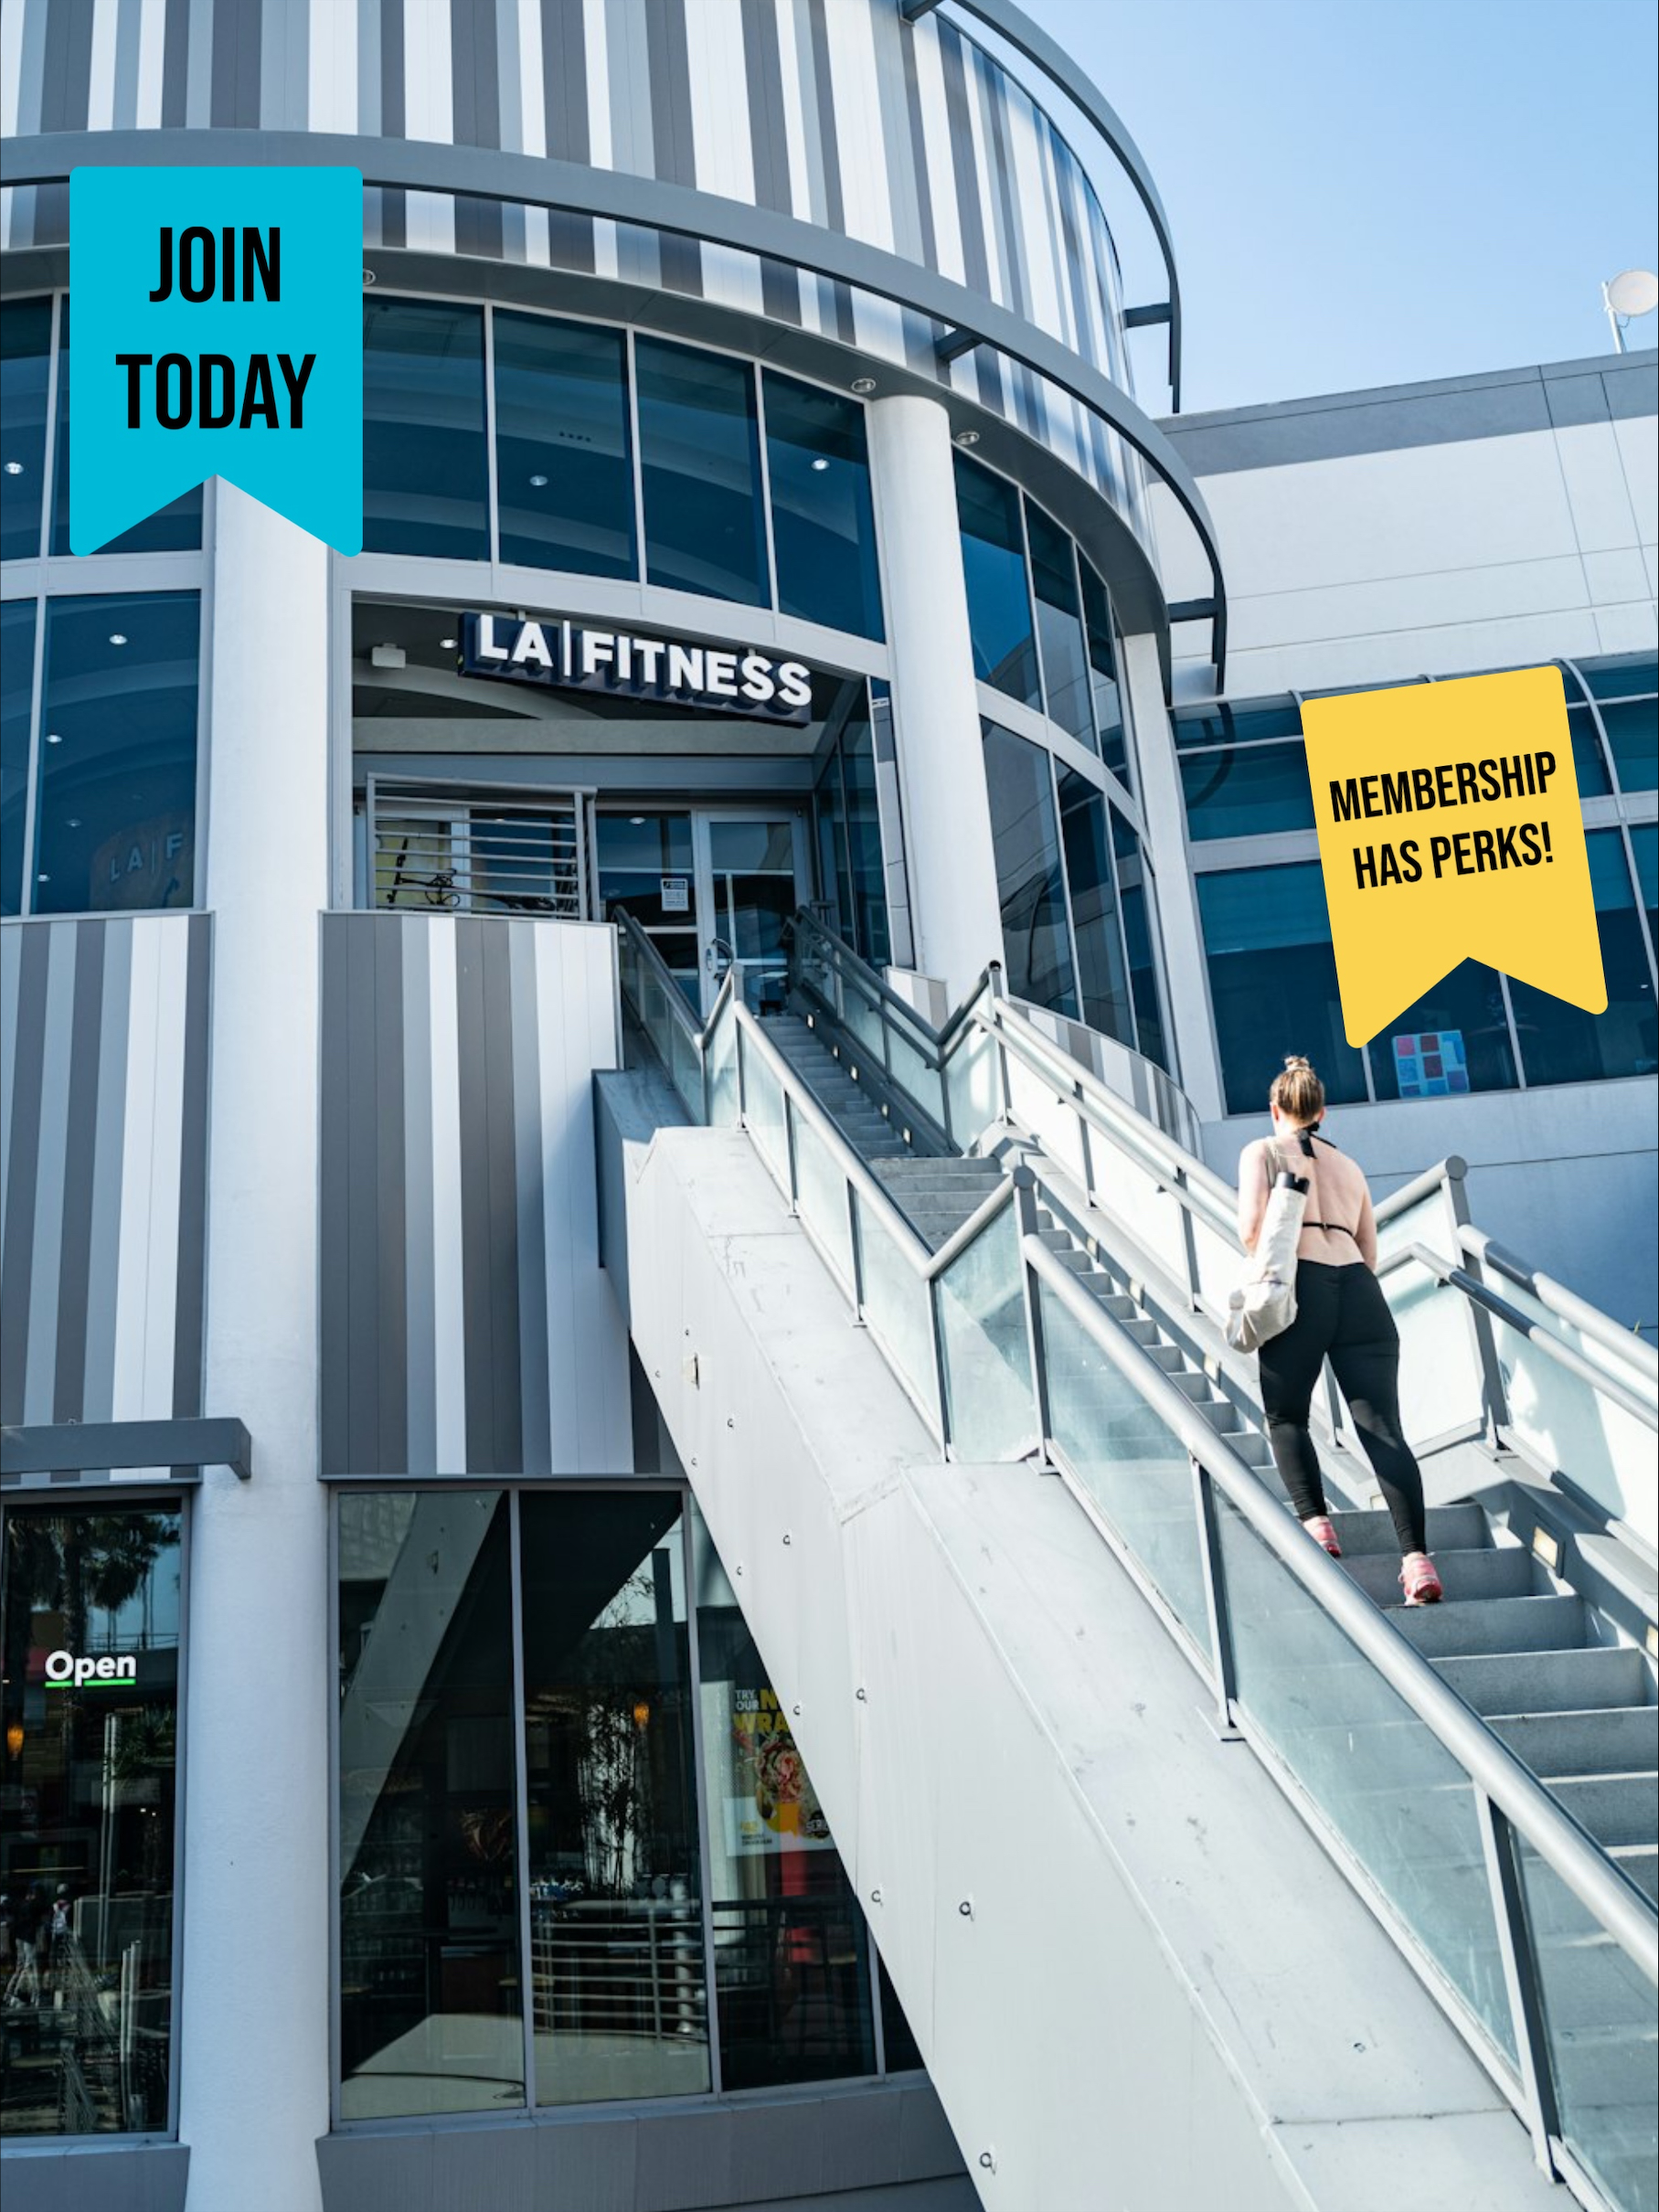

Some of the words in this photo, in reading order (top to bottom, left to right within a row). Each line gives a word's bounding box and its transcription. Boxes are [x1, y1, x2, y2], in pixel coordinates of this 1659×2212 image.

[479, 613, 553, 667] LA
[582, 629, 813, 707] FITNESS
[45, 1650, 136, 1687] Open
[735, 1689, 755, 1700] TRY
[736, 1699, 760, 1711] OUR
